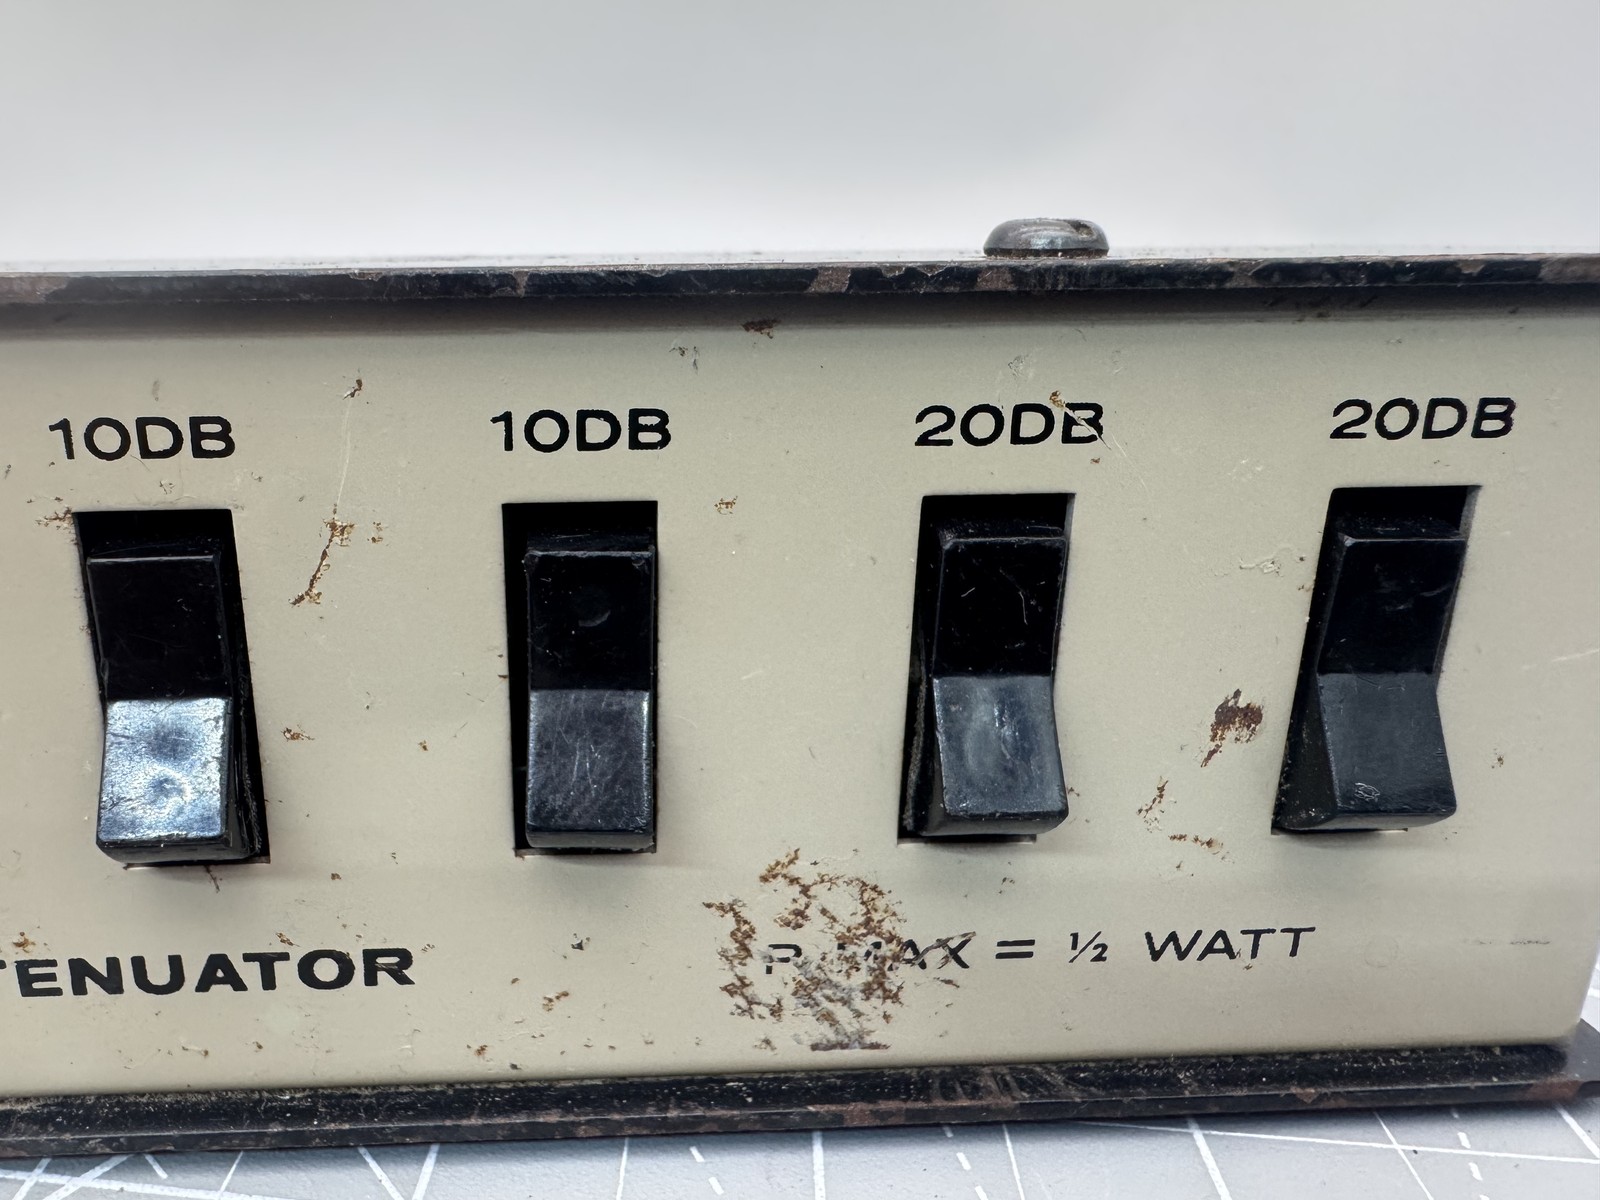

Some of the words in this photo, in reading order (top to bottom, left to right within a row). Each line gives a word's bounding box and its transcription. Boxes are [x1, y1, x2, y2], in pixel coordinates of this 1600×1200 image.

[48, 415, 236, 462] 10DB
[489, 407, 672, 454] 10DB
[914, 402, 1104, 447] 20DB
[1329, 397, 1517, 441] 20DB
[1144, 926, 1316, 962] WATT
[0, 947, 416, 998] ENUATOR
